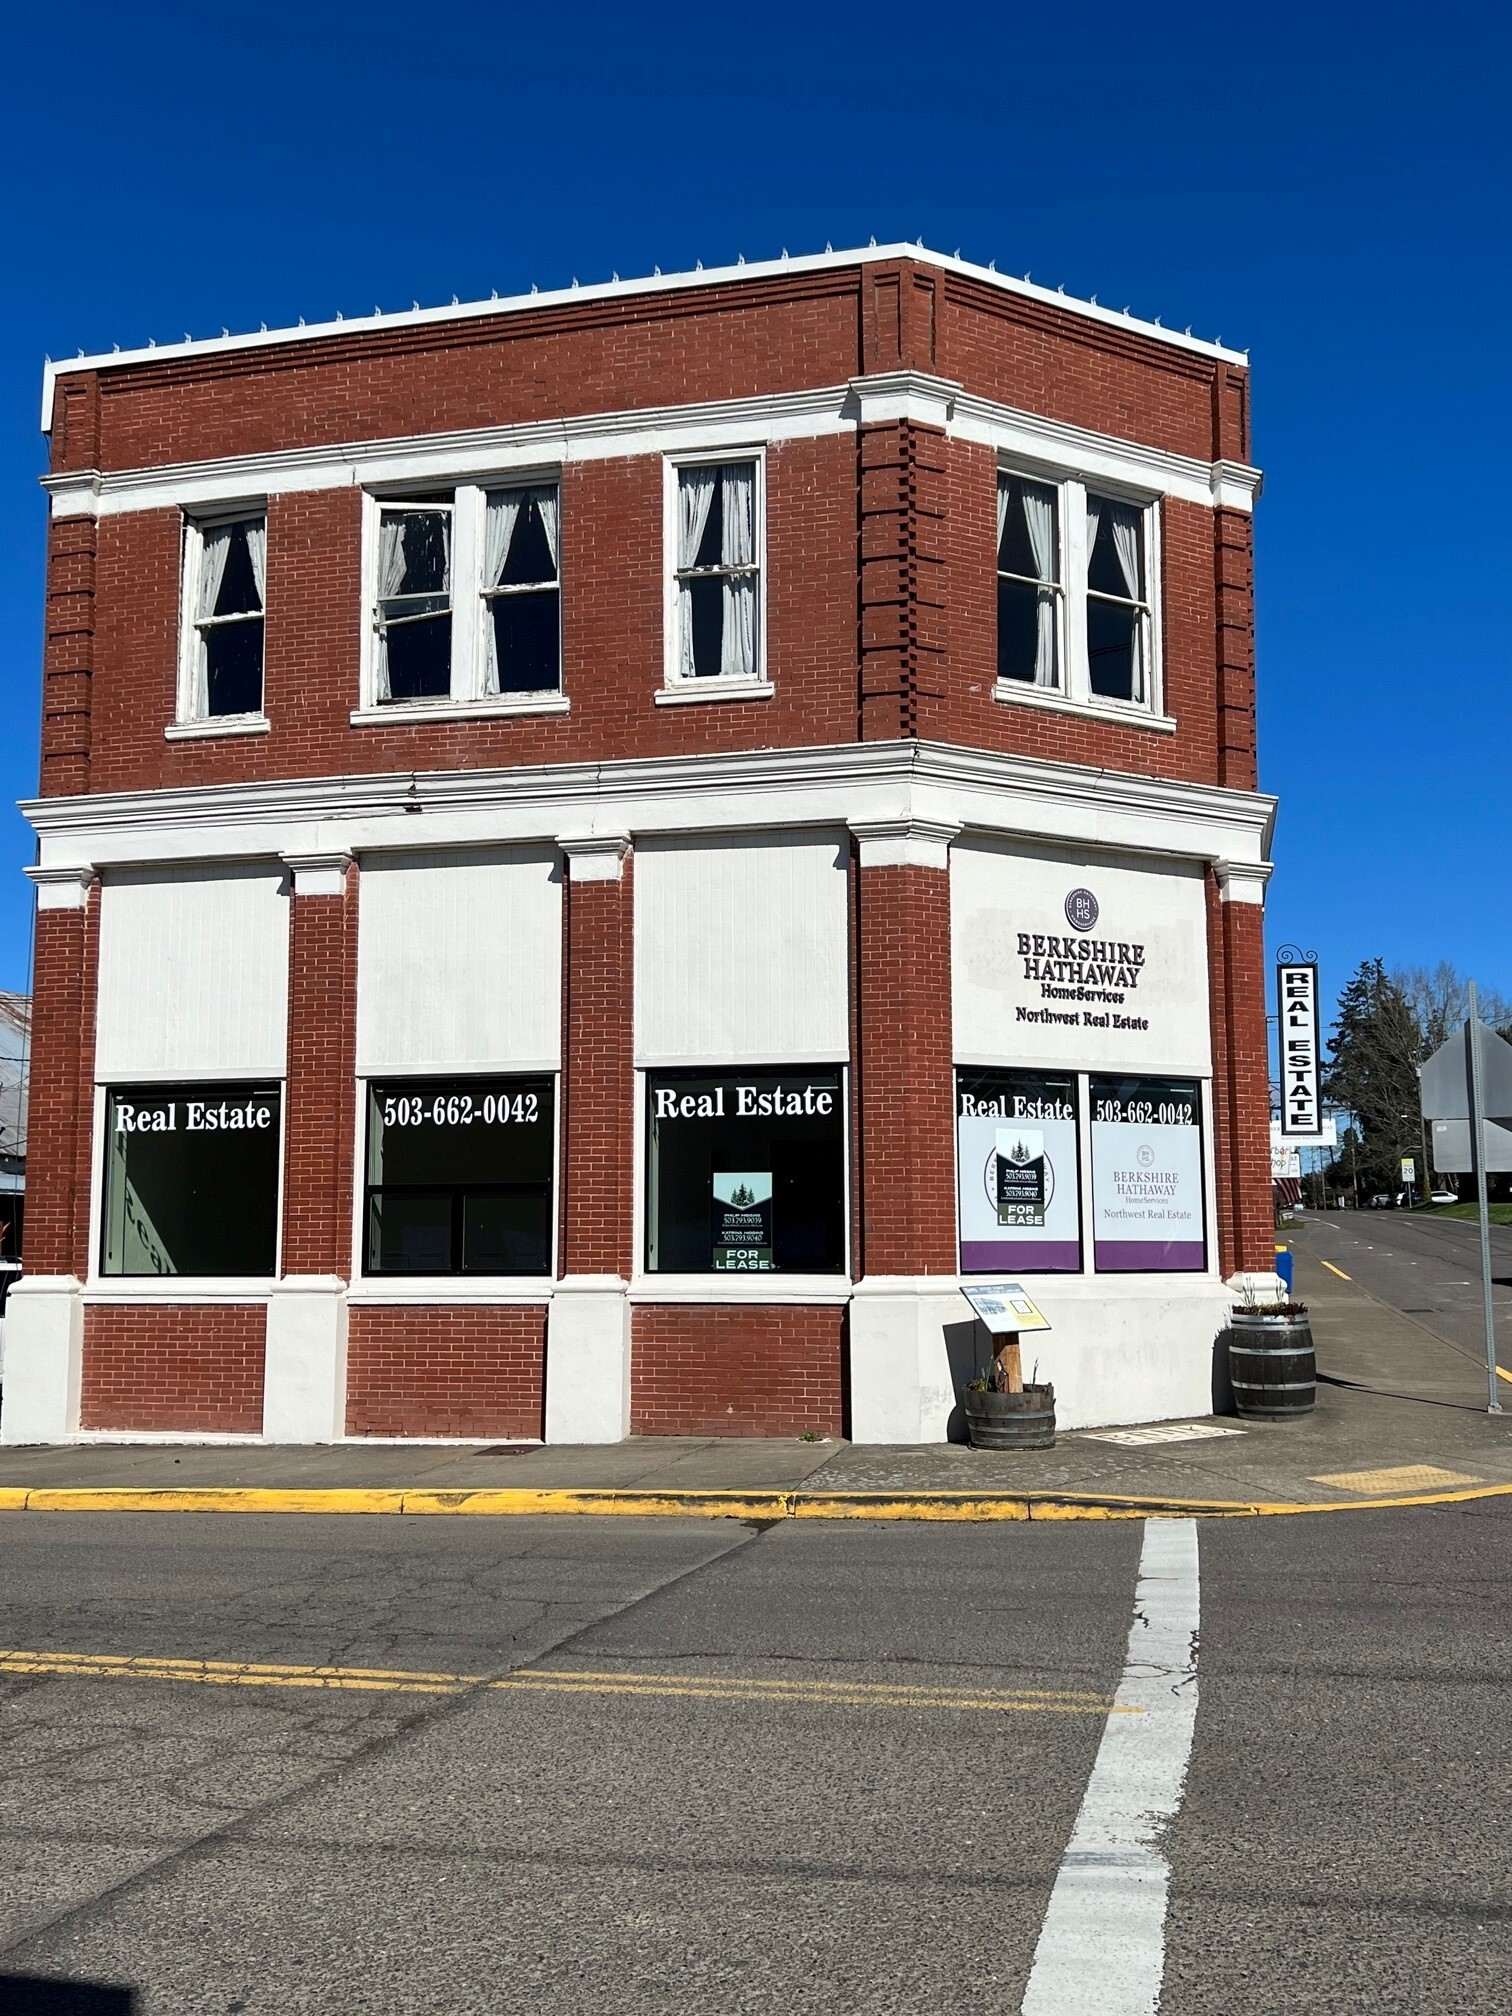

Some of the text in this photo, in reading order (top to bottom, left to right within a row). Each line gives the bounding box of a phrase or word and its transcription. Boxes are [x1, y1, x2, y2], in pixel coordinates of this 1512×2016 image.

[1076, 897, 1090, 909] BH
[1076, 908, 1091, 920] HS
[1017, 932, 1146, 966] BERKSHIRE
[1023, 957, 1141, 989] HATHAWAY
[1041, 983, 1125, 1004] HomeServices
[1286, 972, 1310, 1027] REAL
[1015, 1006, 1149, 1031] Northwest Real Estate
[1288, 1040, 1314, 1126] ESTATE
[384, 1093, 539, 1127] 503-662-0042
[655, 1085, 833, 1119] Real Estate
[960, 1093, 1074, 1121] Real Estate
[115, 1101, 271, 1132] Real Estate
[1096, 1099, 1193, 1126] 503-662-0042
[1113, 1171, 1179, 1184] BERKSHIRE
[1403, 1167, 1414, 1175] 20
[1116, 1184, 1177, 1196] HATHAWAY
[1125, 1196, 1169, 1205] HomeServices
[1008, 1205, 1035, 1214] FOR
[1103, 1208, 1192, 1220] Northwest Real Estate
[999, 1215, 1043, 1224] LEASE
[726, 1250, 759, 1259] FOR
[715, 1260, 770, 1269] LEASE
